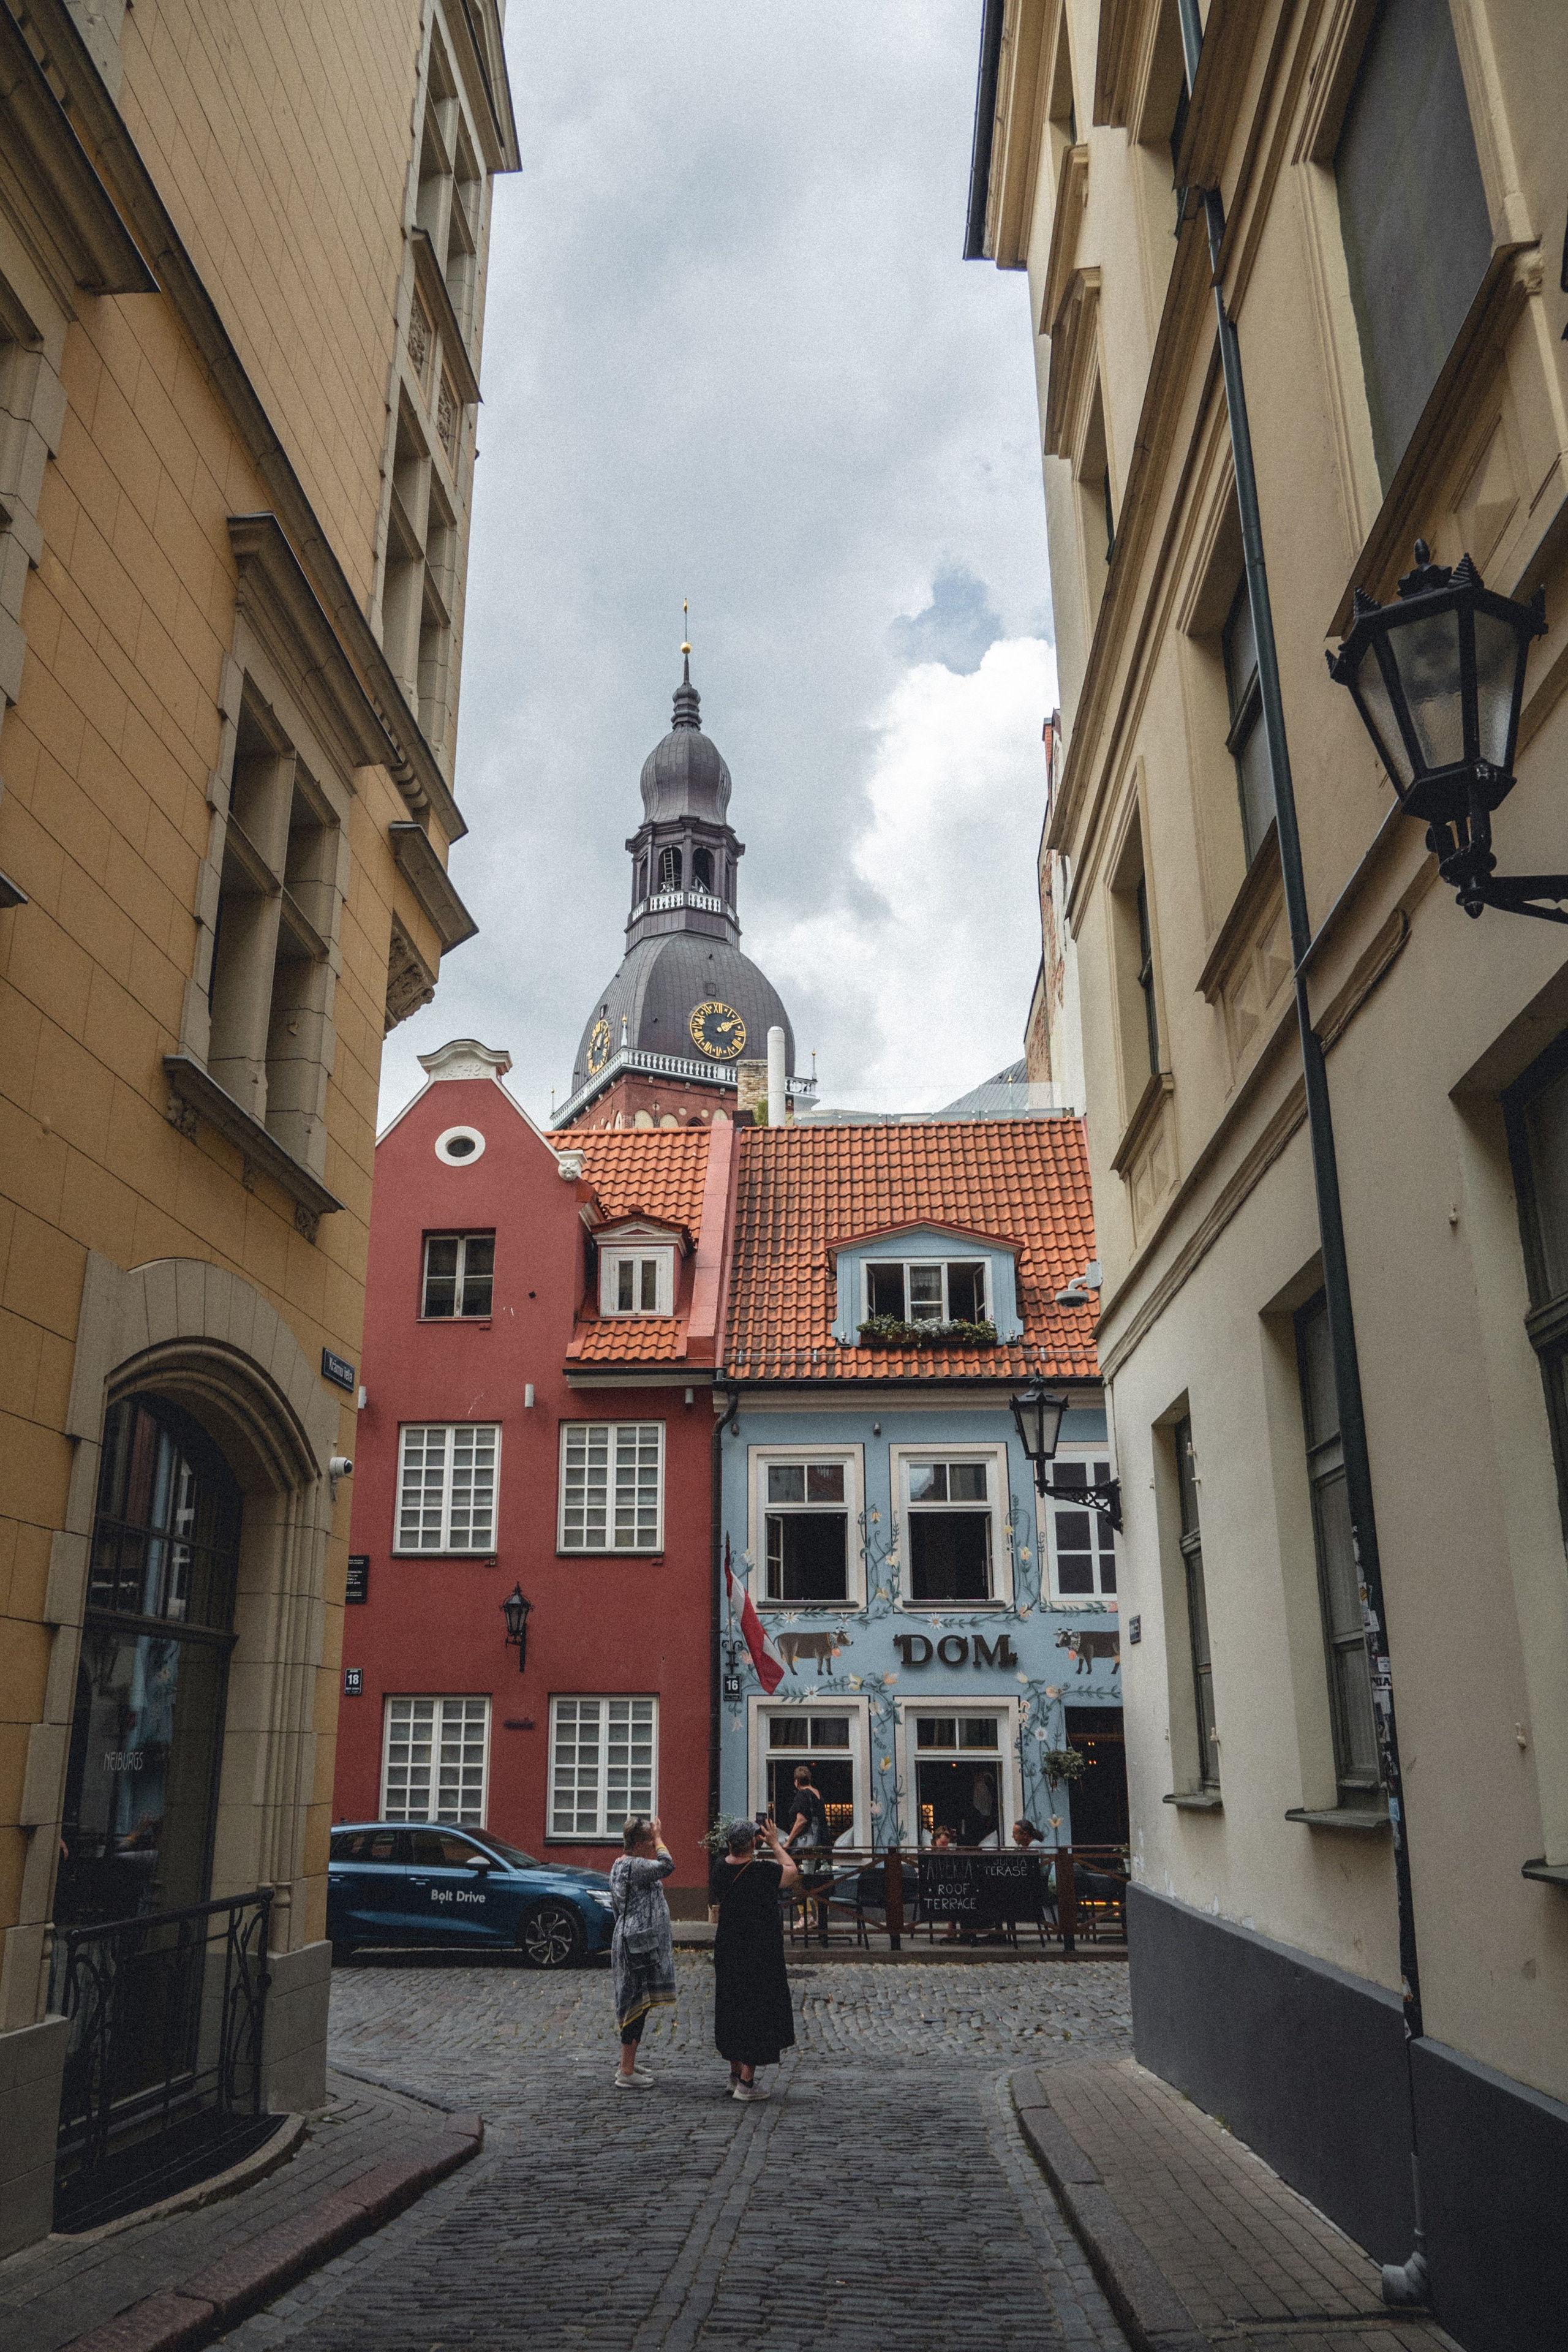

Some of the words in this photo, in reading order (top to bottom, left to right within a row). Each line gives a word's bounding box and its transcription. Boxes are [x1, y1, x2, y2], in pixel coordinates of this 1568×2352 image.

[701, 1004, 712, 1016] XI
[713, 1003, 723, 1014] XII
[726, 1009, 733, 1017] I
[693, 1031, 705, 1044] VIII
[703, 1041, 712, 1054] VII
[716, 1046, 723, 1057] VI
[726, 1046, 734, 1056] V
[344, 1366, 353, 1383] iela
[894, 1634, 1017, 1666] DOM
[348, 1674, 359, 1685] 18
[726, 1679, 738, 1691] 16
[104, 1752, 143, 1771] NEIBURGS
[984, 1866, 1027, 1876] TERASE
[938, 1883, 970, 1894] ROOF
[431, 1889, 453, 1904] Bolt
[456, 1890, 486, 1903] Drive
[924, 1898, 977, 1909] TERRACE
